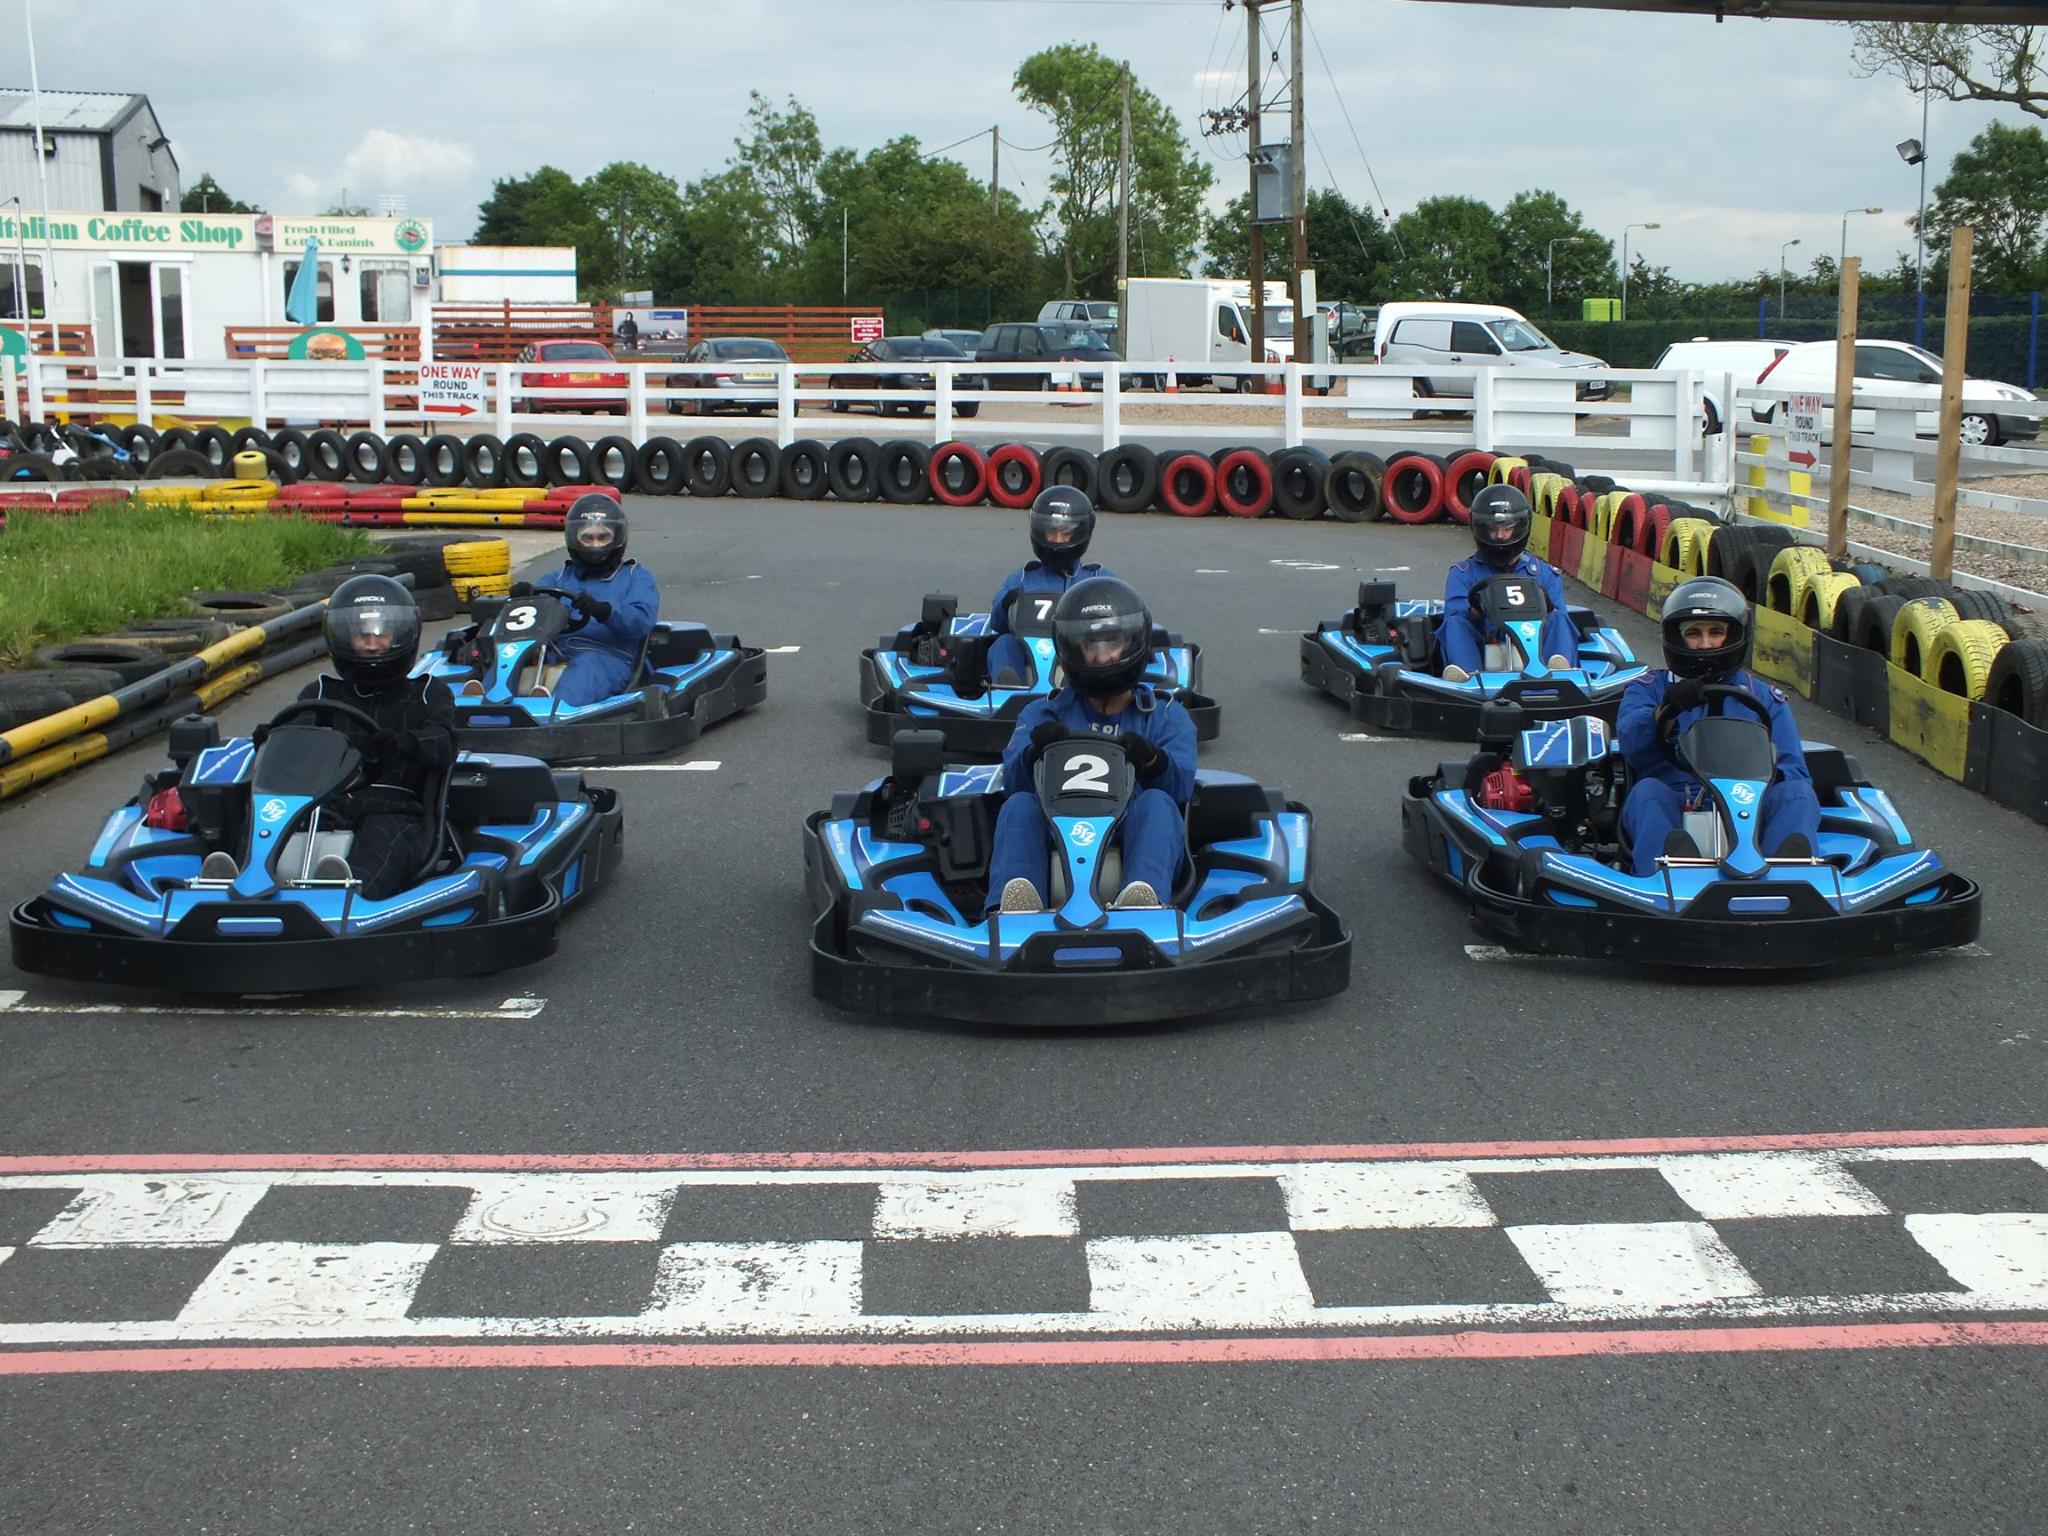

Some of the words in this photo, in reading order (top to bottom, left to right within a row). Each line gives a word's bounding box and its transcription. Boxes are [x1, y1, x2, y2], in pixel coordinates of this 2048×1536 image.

[87, 217, 171, 242] Coffee
[180, 219, 243, 248] Shop
[284, 225, 318, 234] Fresh
[320, 225, 356, 234] Filled
[328, 238, 375, 248] Paninis
[421, 365, 449, 379] ONE
[451, 366, 481, 380] WAY
[433, 379, 469, 391] ROUND
[422, 391, 445, 399] THIS
[446, 391, 480, 400] TRACK
[1790, 395, 1804, 413] ONE
[1805, 395, 1822, 414] WAY
[1795, 416, 1814, 430] ROUND
[1506, 585, 1525, 606] 5
[505, 605, 538, 631] 3
[1034, 599, 1053, 620] 7
[1061, 754, 1110, 793] 2
